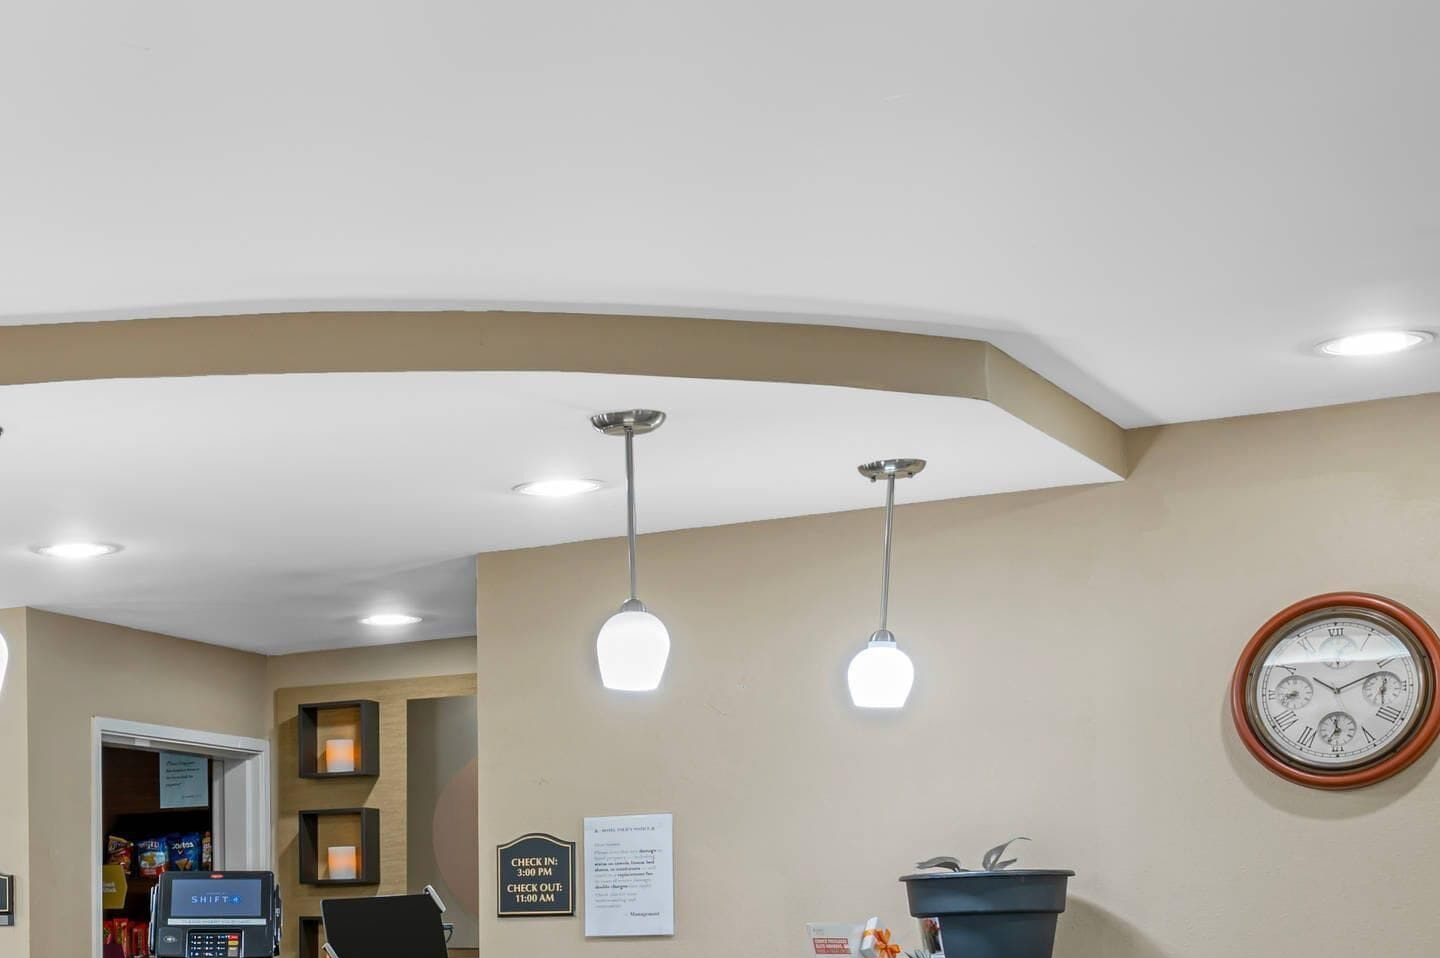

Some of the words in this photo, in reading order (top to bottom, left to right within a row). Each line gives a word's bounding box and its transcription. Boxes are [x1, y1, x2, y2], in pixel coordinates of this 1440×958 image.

[511, 858, 542, 867] CHECK
[544, 857, 558, 866] IN:
[517, 868, 536, 877] 3:00
[538, 868, 552, 876] PM
[507, 884, 538, 893] CHECK
[539, 882, 563, 892] OUT:
[516, 894, 537, 903] 11:00
[539, 894, 554, 902] AM
